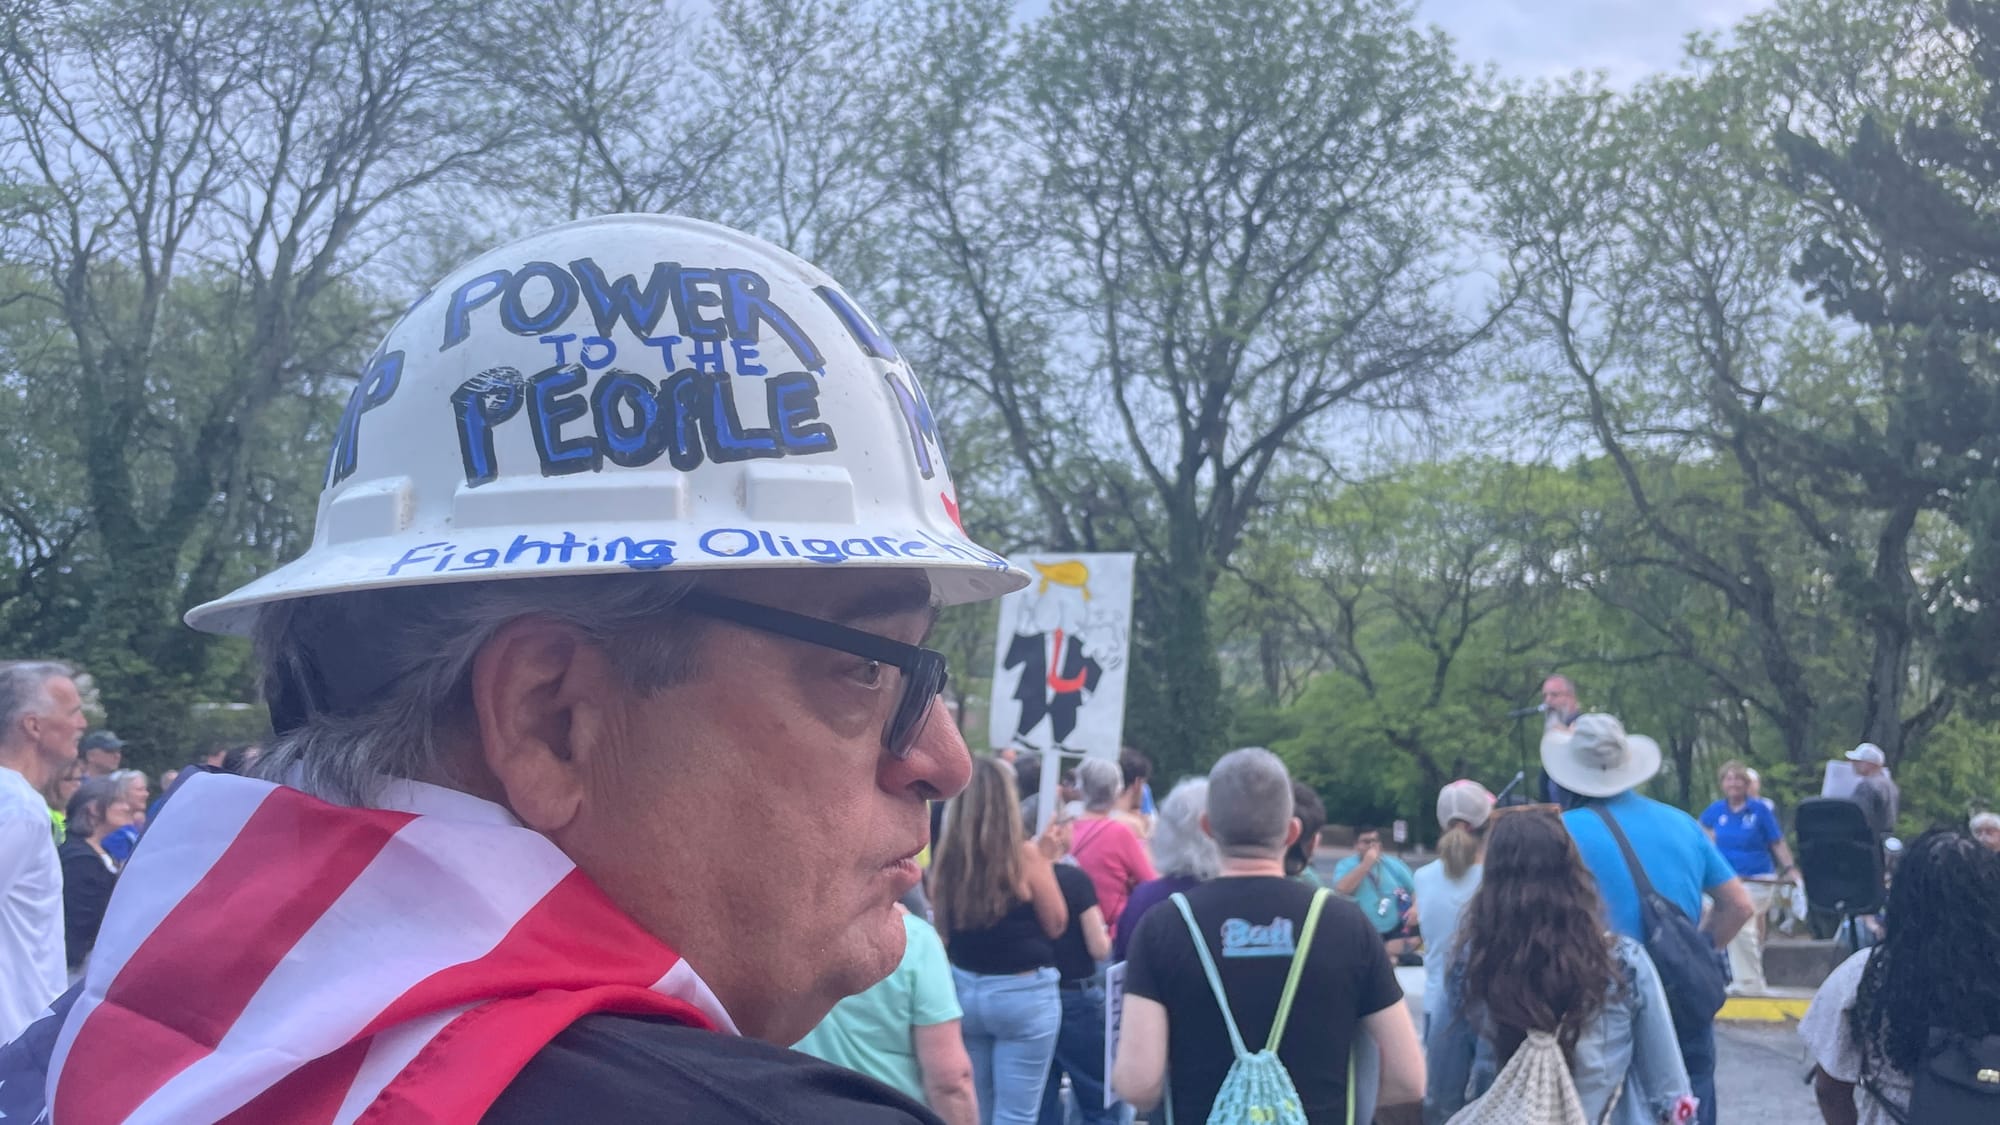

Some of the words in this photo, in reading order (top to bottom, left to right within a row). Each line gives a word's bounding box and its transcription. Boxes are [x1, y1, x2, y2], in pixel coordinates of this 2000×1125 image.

[439, 257, 826, 376] POWER
[540, 333, 617, 370] TO
[645, 335, 768, 376] THE
[450, 364, 838, 488] PEOPLE
[387, 531, 677, 570] Fighting
